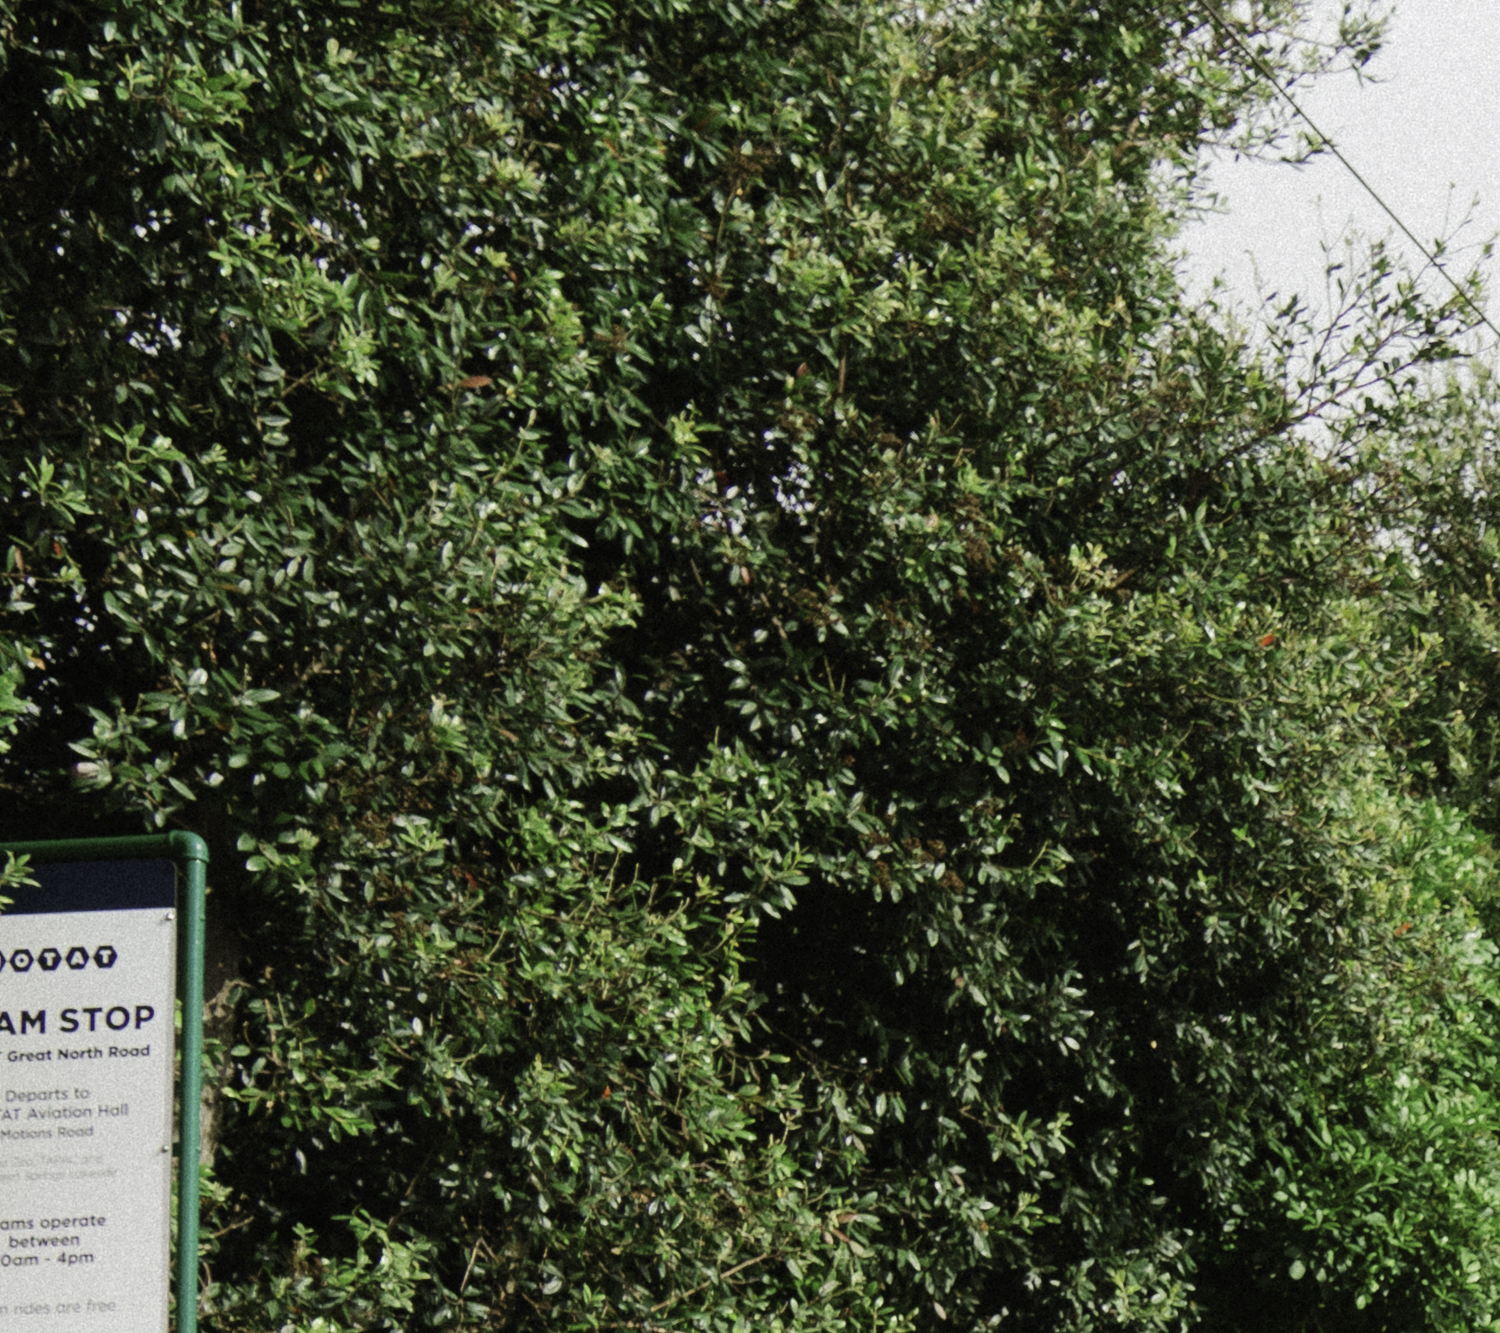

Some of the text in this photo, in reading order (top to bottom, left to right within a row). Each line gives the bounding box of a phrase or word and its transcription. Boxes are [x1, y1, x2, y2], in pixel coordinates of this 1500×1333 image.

[9, 946, 118, 972] OTAT
[60, 1005, 155, 1033] STOP
[7, 1044, 151, 1062] Great North Road
[5, 1088, 90, 1103] Departs to
[27, 1108, 93, 1120] Aviation
[98, 1103, 129, 1117] Hall
[57, 1125, 94, 1137] Road
[40, 1215, 106, 1230] operate
[9, 1235, 80, 1249] between
[56, 1252, 94, 1267] 4pm
[55, 1303, 81, 1314] are
